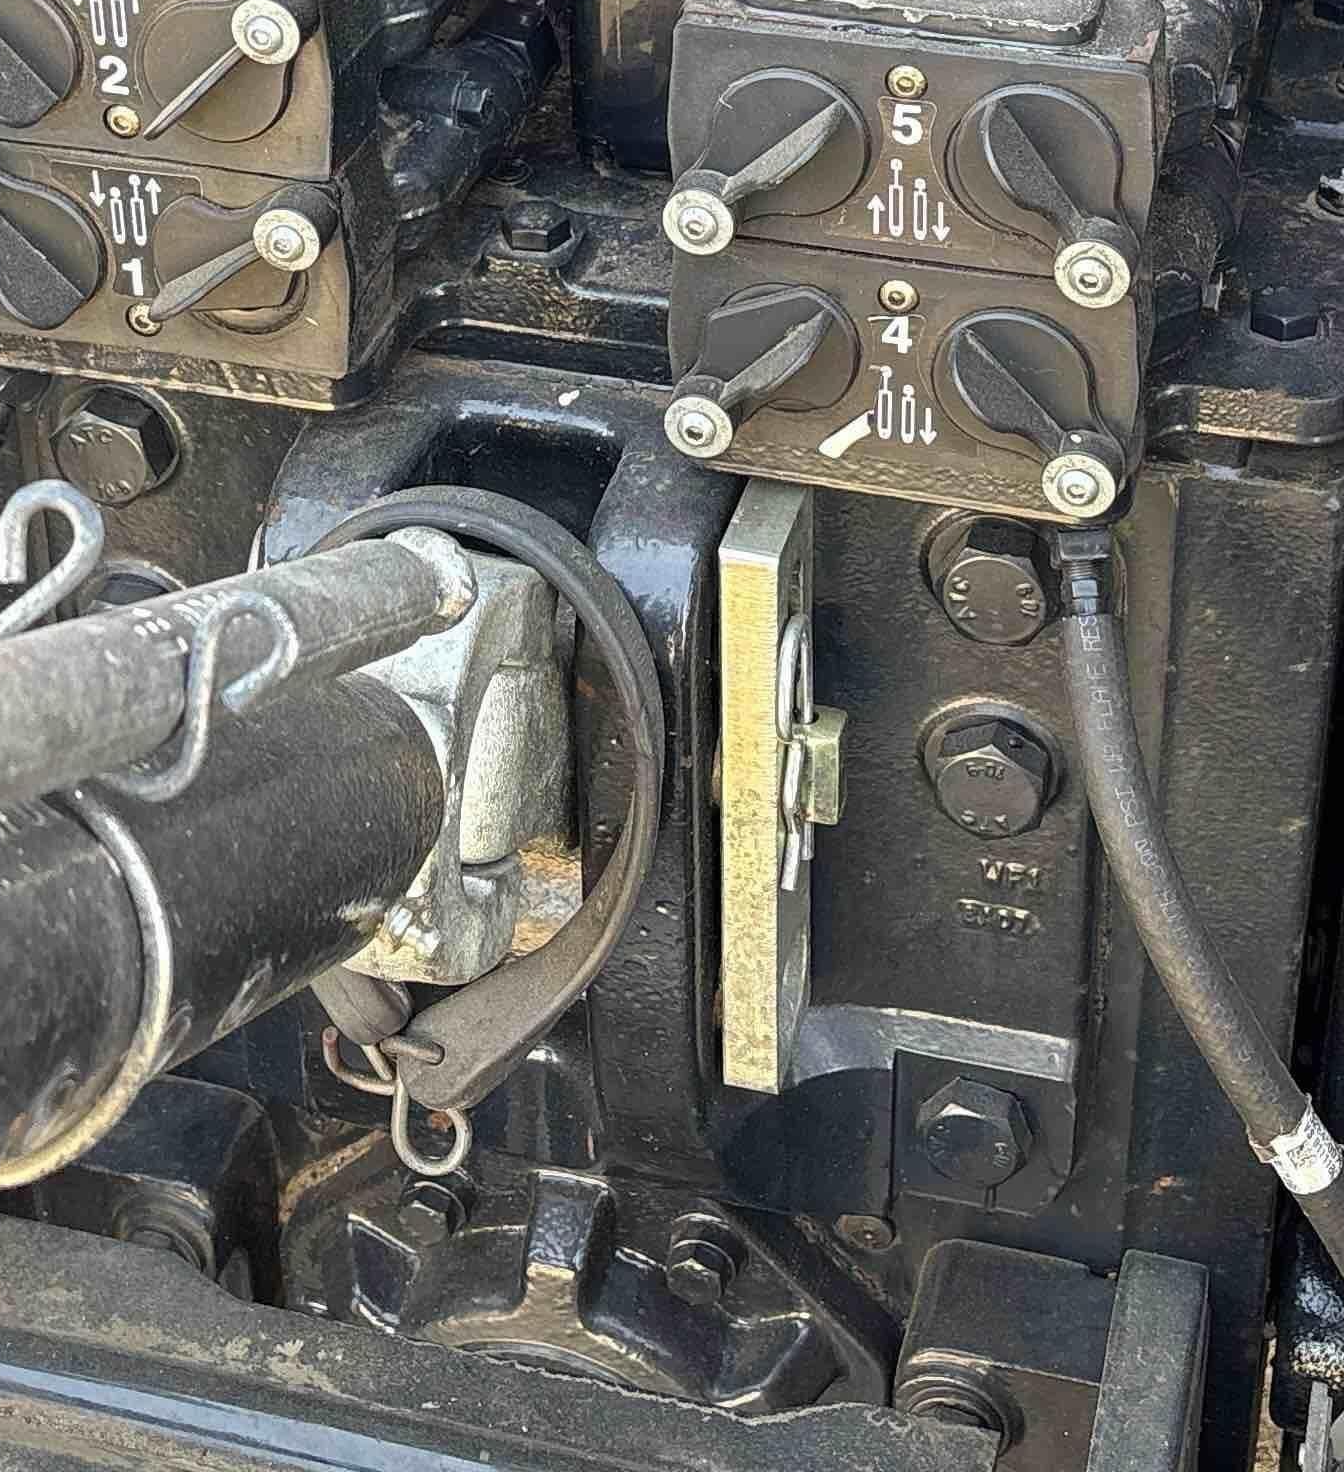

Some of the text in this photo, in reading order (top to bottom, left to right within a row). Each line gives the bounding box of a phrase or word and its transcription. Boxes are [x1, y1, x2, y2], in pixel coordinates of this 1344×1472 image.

[99, 55, 130, 96] 2
[891, 103, 924, 145] 5
[121, 258, 144, 297] 1
[881, 315, 913, 354] 4
[1114, 785, 1144, 827] PSI
